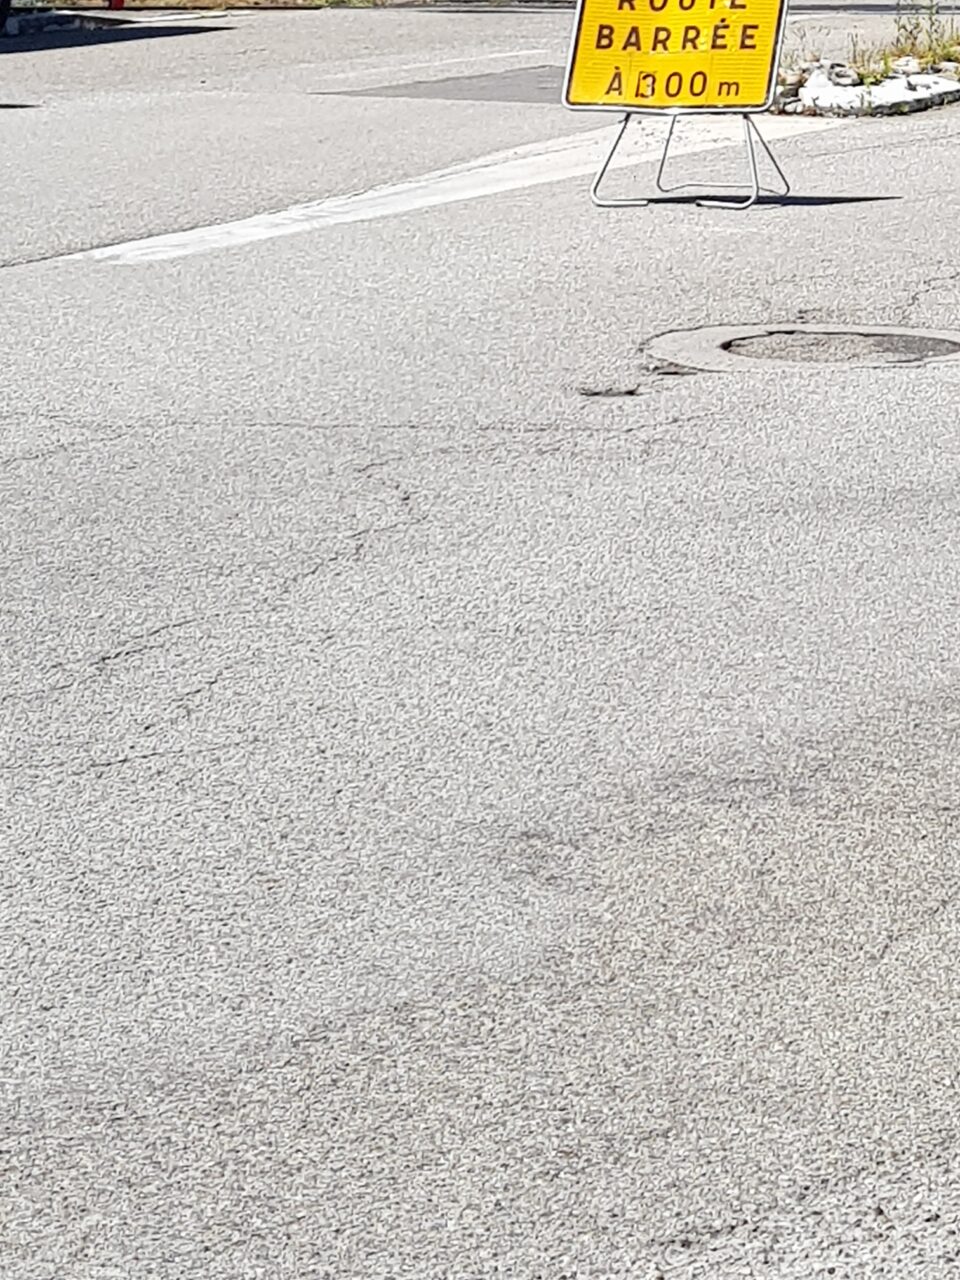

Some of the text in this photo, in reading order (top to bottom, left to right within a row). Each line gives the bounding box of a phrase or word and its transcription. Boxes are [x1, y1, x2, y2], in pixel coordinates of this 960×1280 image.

[595, 18, 759, 51] BARRÉE
[605, 66, 623, 96] À
[717, 80, 740, 96] m
